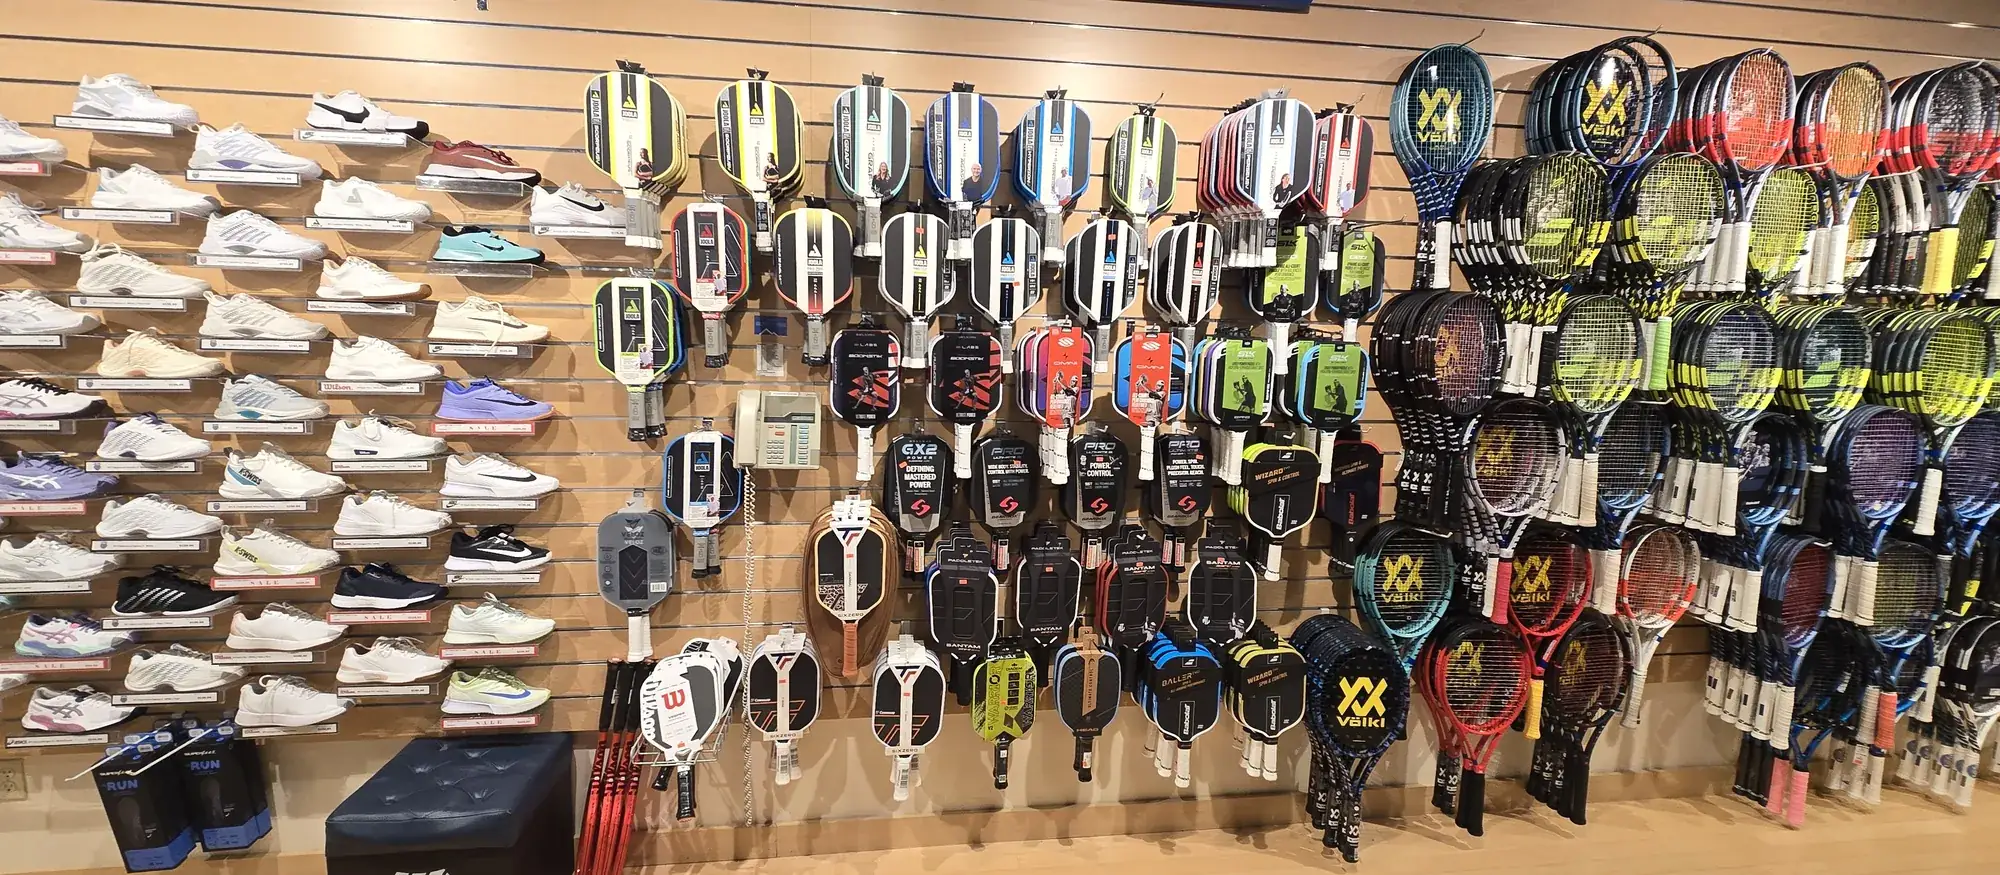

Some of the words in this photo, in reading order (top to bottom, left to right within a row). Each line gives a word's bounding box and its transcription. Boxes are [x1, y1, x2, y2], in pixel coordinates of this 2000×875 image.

[1417, 125, 1461, 143] Völkl
[1581, 123, 1626, 137] Völkl
[901, 443, 938, 455] GX2
[991, 447, 1025, 455] PRO
[1084, 442, 1117, 450] PRO
[1168, 440, 1200, 449] PRO
[1255, 467, 1284, 481] WIZARD
[1267, 477, 1277, 485] SPIN
[1283, 471, 1300, 481] CONTROL
[1276, 498, 1285, 530] Babolat
[1162, 673, 1192, 687] BALLER
[1247, 670, 1273, 684] WIZARD
[1336, 716, 1386, 728] Völkl
[190, 760, 221, 770] RUN
[107, 779, 139, 791] RUN
